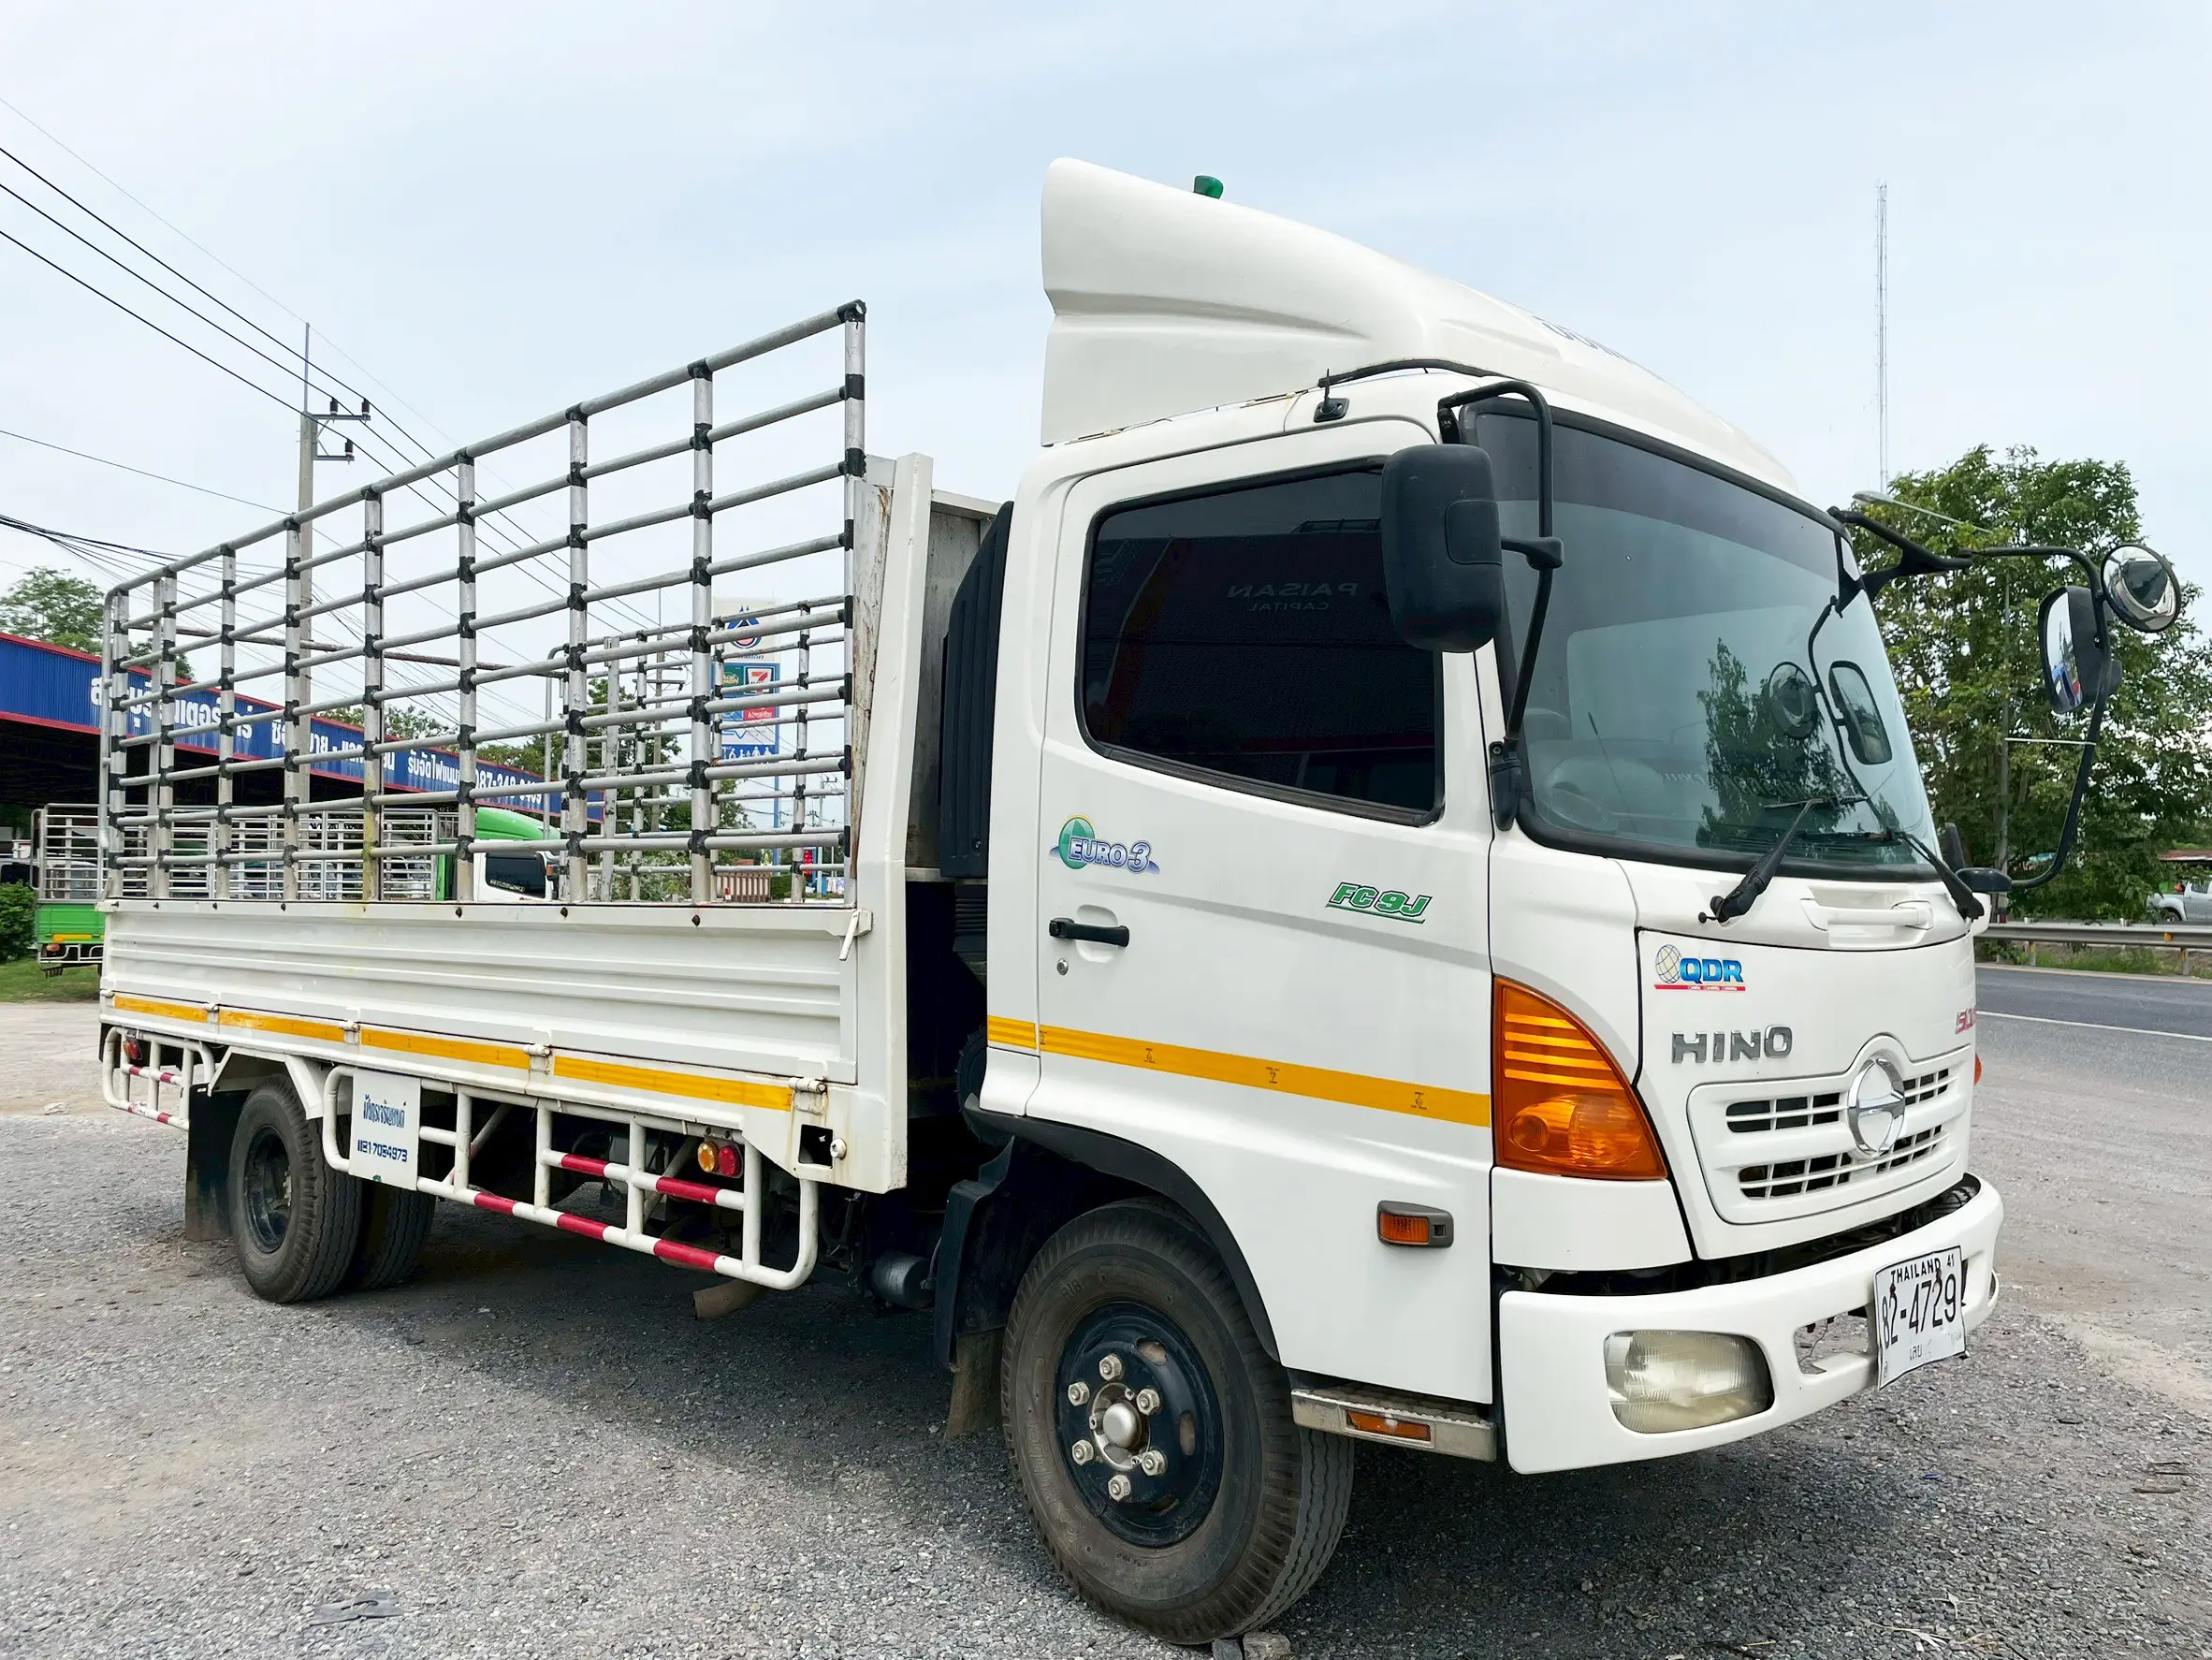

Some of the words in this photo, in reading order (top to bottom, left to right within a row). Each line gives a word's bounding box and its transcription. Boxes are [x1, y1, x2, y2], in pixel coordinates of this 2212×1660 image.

[1680, 957, 1743, 984] QDR
[1671, 1025, 1794, 1064] HINO
[1890, 1258, 1942, 1284] THAILAND
[1882, 1274, 1957, 1349] 82-4729
